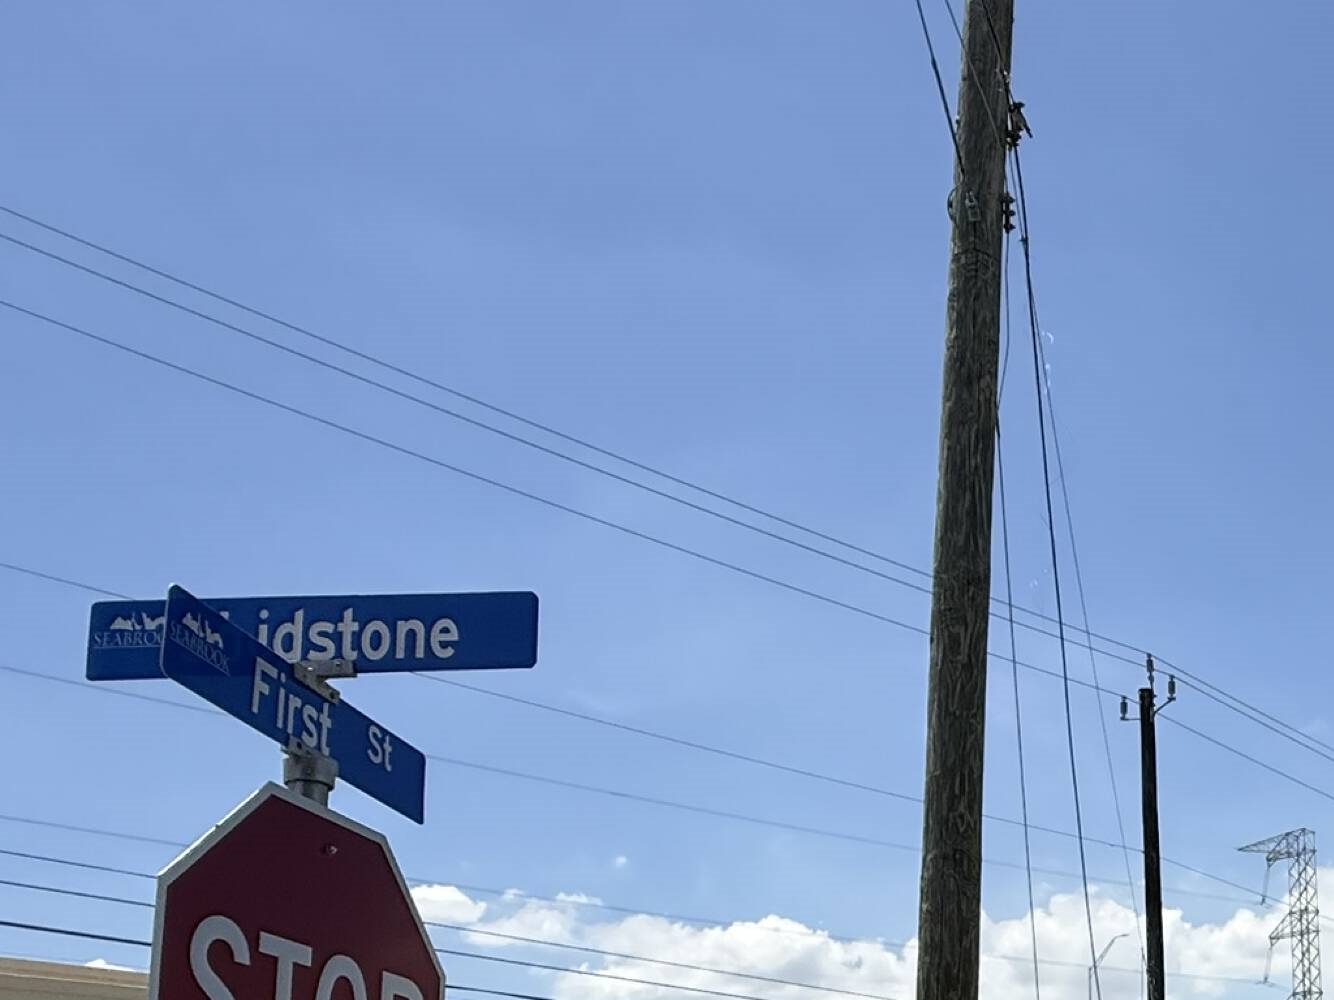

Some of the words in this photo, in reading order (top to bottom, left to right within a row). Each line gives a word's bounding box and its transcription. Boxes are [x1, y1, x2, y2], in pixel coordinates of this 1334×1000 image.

[94, 631, 162, 647] SEABRO
[219, 608, 459, 661] idstone
[252, 657, 332, 755] First
[367, 725, 392, 771] St
